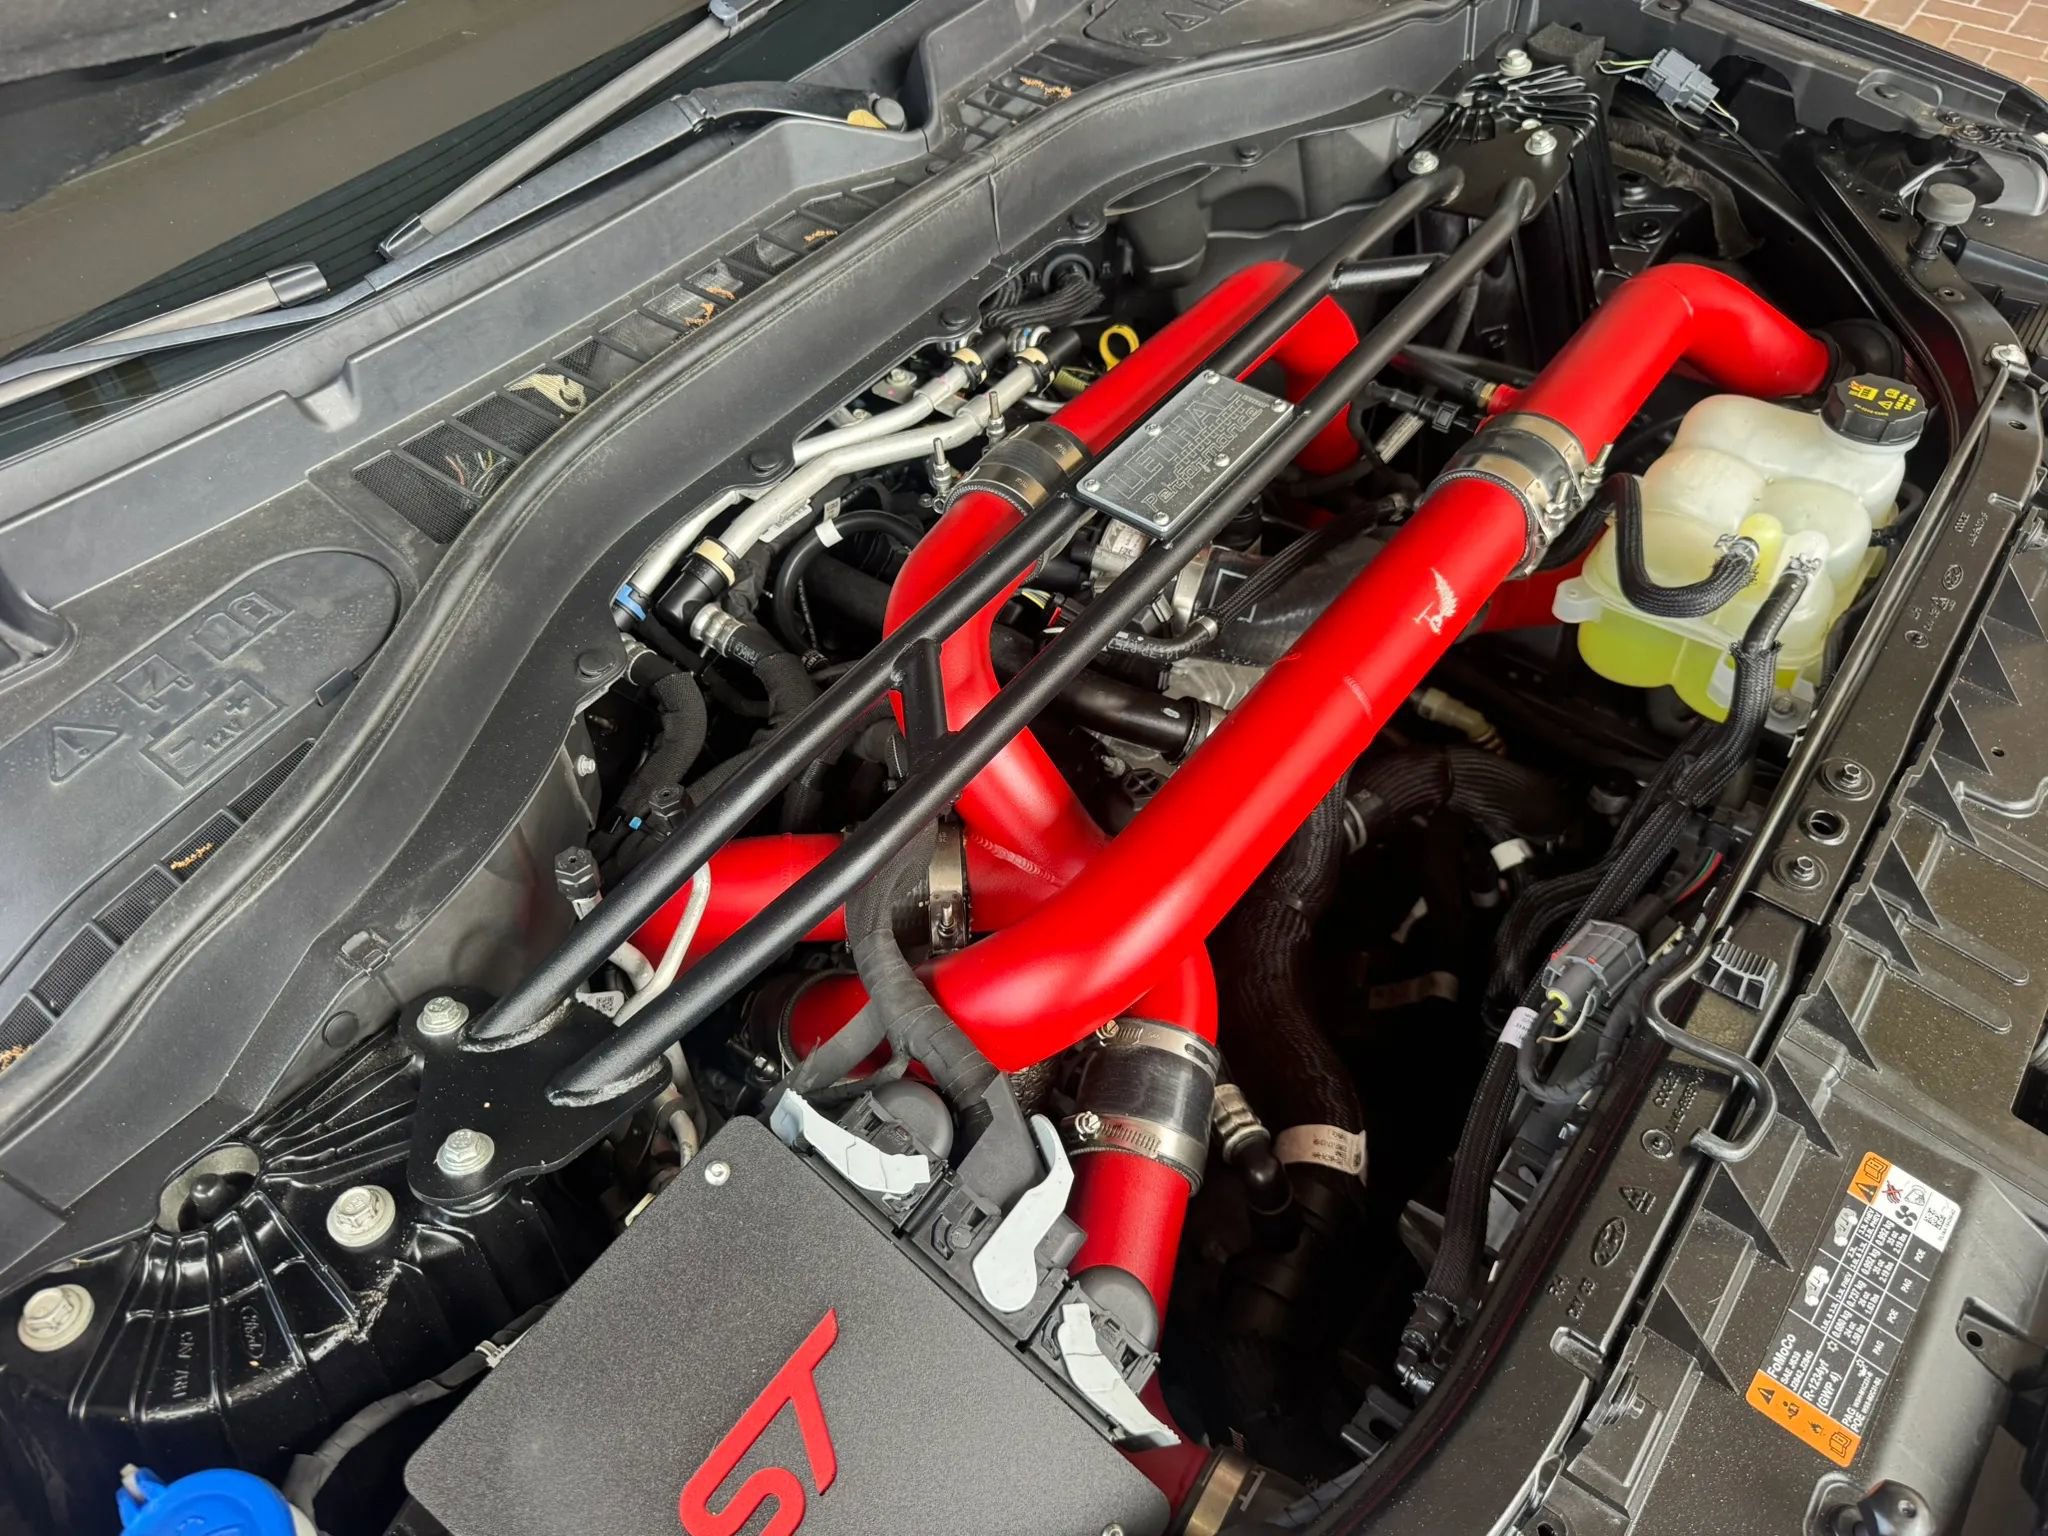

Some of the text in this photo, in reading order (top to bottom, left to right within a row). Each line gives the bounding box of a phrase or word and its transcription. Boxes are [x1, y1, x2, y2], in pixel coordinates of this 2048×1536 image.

[1107, 387, 1240, 499] LETHAL
[1141, 407, 1264, 512] Performance
[203, 719, 240, 752] 12V
[1882, 1219, 1894, 1229] kg
[1891, 1230, 1898, 1238] oz
[1898, 1233, 1907, 1242] lbs
[1868, 1248, 1880, 1258] kg
[1914, 1248, 1925, 1262] POE
[1877, 1259, 1884, 1267] oz
[1884, 1261, 1893, 1271] lbs
[1900, 1278, 1912, 1292] PAG
[1846, 1280, 1866, 1307] 0.737 kg
[1862, 1291, 1870, 1299] oz
[1869, 1293, 1879, 1303] lbs
[1839, 1309, 1852, 1320] kg
[1886, 1308, 1898, 1323] POE
[1848, 1321, 1856, 1329] oz
[1855, 1323, 1865, 1334] lbs
[1872, 1340, 1884, 1354] PAG
[1767, 1334, 1795, 1377] FoMoCo
[1780, 1351, 1800, 1384] SAE J639
[1790, 1350, 1813, 1390] J2842 J2845
[1803, 1358, 1828, 1400] R-1234yf
[1816, 1371, 1842, 1410] (GWP 4)
[679, 1306, 840, 1536] ST
[1842, 1407, 1855, 1426] PAG
[1850, 1412, 1865, 1432] POE
